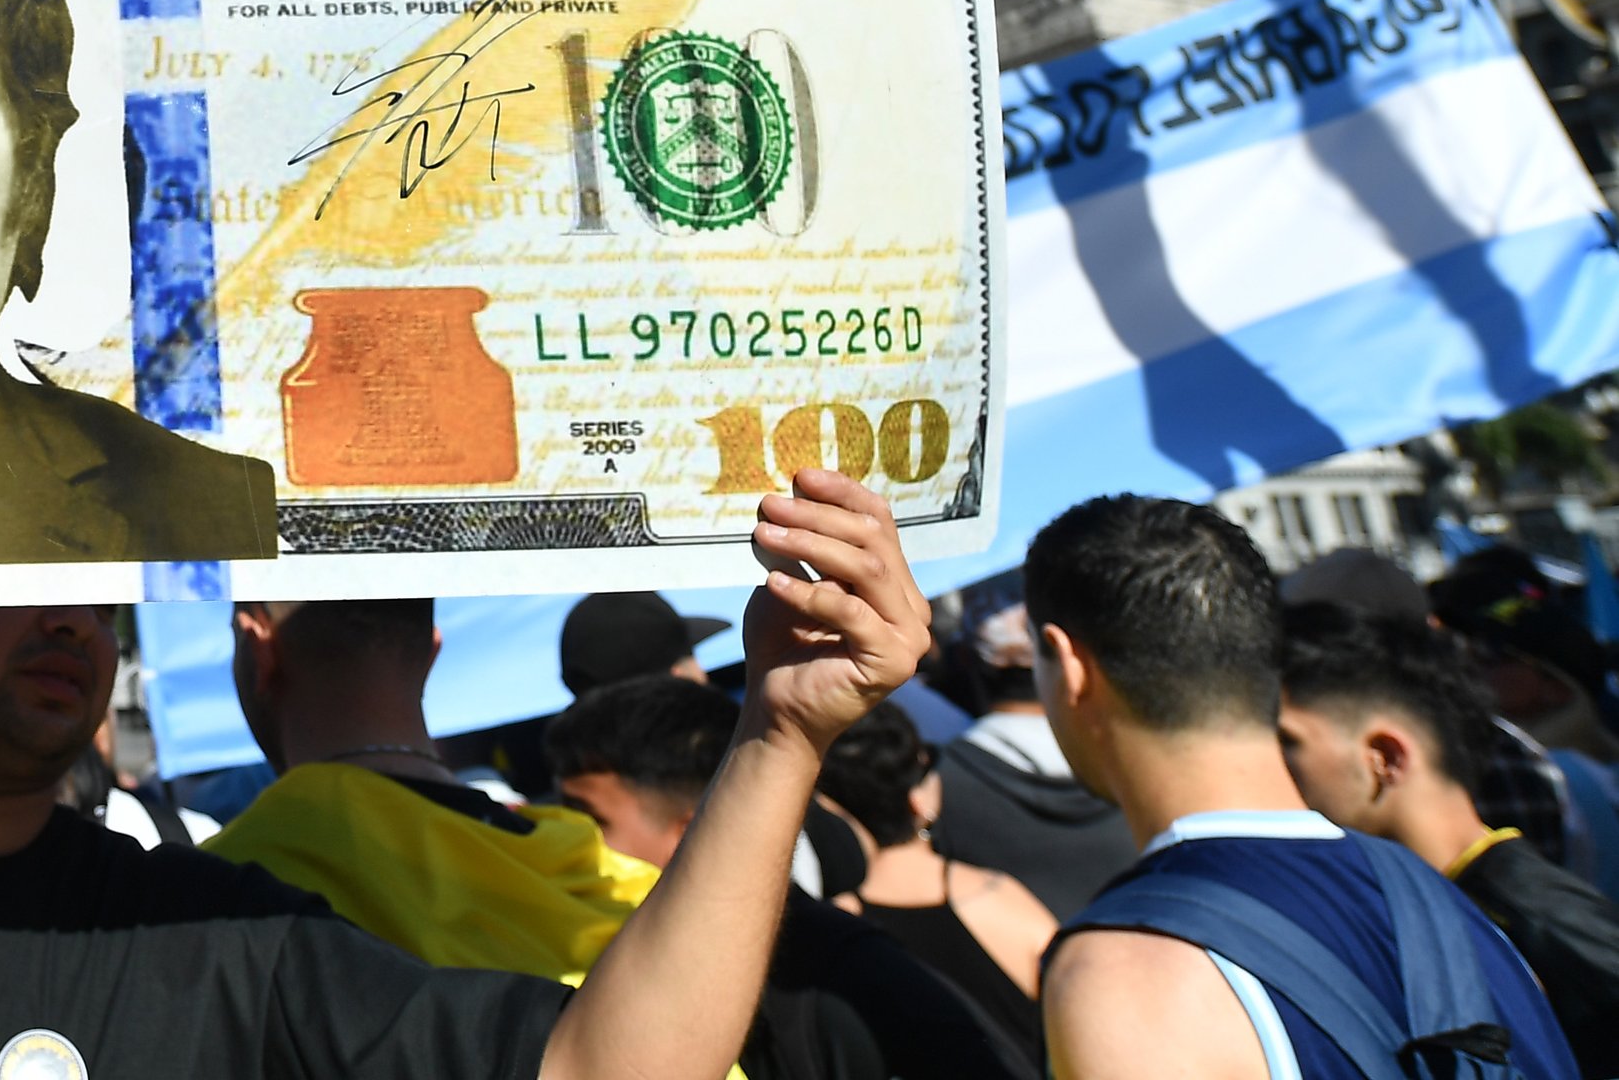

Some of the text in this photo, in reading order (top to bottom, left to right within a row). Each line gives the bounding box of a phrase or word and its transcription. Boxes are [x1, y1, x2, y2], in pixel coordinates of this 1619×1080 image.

[227, 0, 619, 18] FOR ALL DEBTS, PUBLIC AND PRIVATE
[693, 45, 719, 61] OF
[569, 420, 644, 437] SERIES
[582, 439, 636, 455] 2009
[696, 398, 951, 495] 100
[603, 458, 618, 473] A
